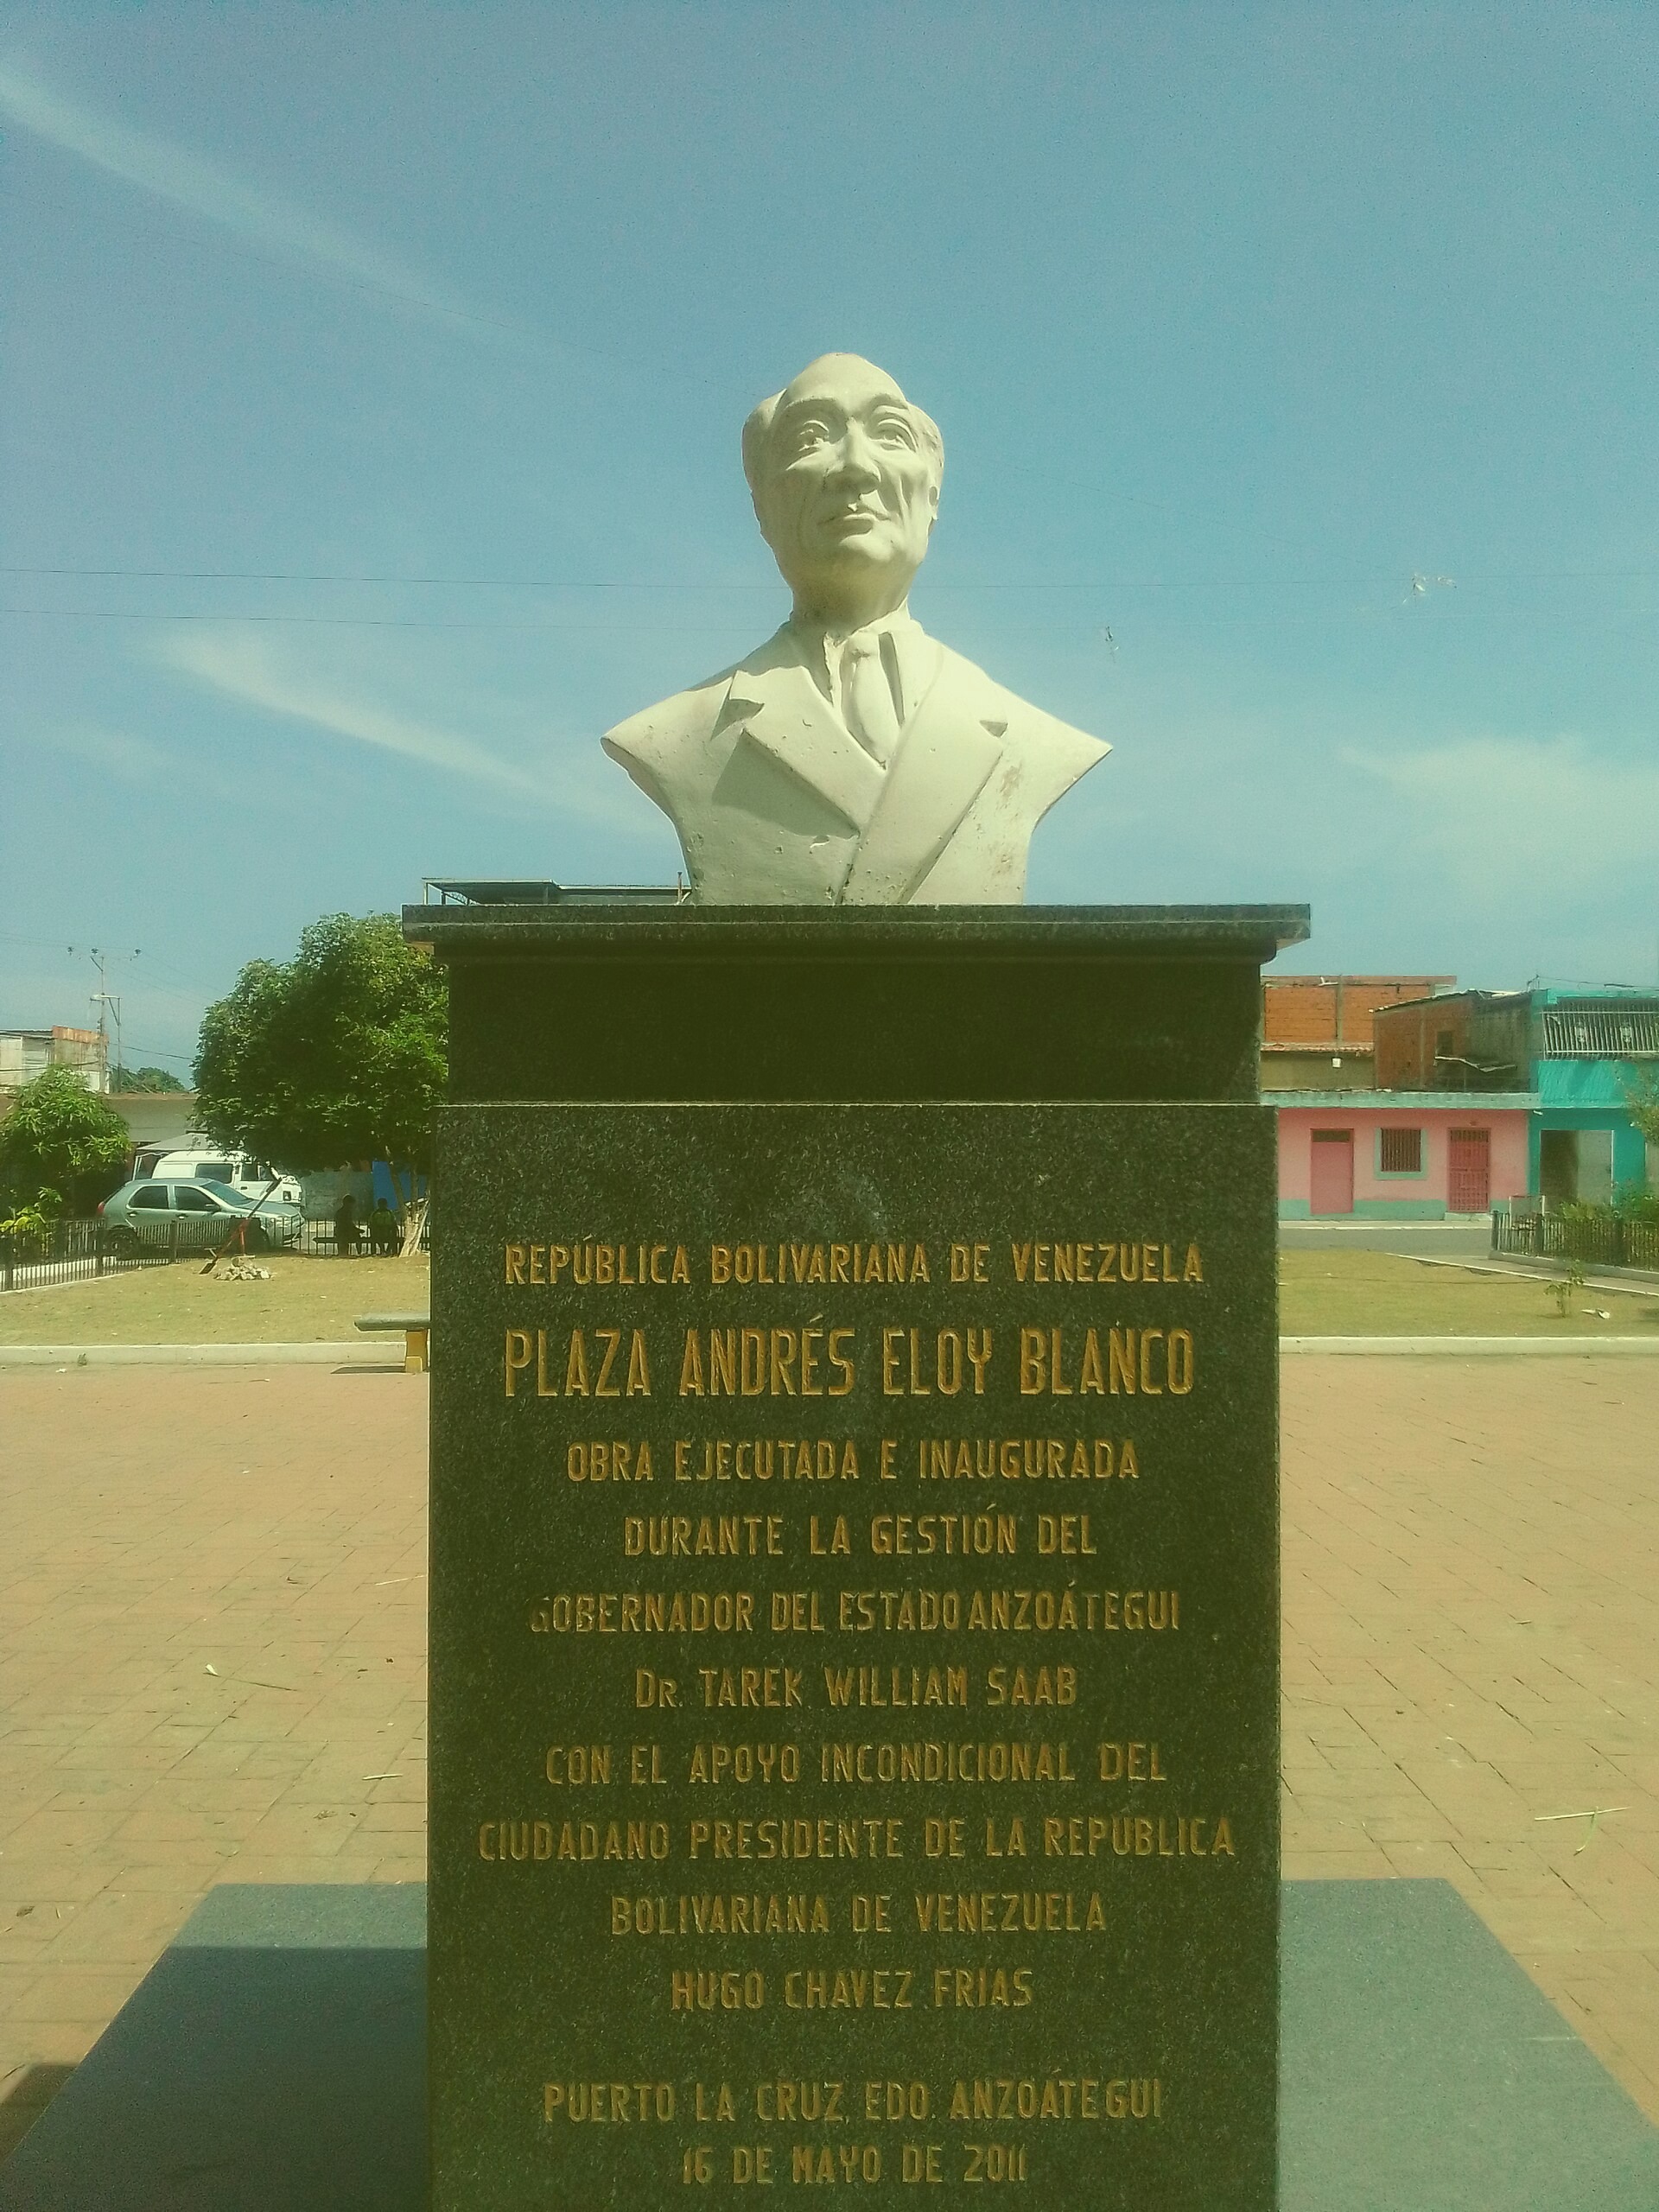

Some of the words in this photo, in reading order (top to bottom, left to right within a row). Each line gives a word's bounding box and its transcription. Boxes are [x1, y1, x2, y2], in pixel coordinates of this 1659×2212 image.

[505, 1233, 690, 1284] REPÚBLICA
[711, 1243, 930, 1284] BOLIVARIANA
[950, 1244, 989, 1283] DE
[1011, 1243, 1203, 1283] VENEZUELA
[505, 1328, 652, 1396] PLAZA
[680, 1313, 855, 1396] ANDRÉS
[883, 1327, 992, 1395] ELOY
[1020, 1327, 1193, 1395] BLANCO
[567, 1442, 653, 1482] OBRA
[675, 1440, 858, 1481] EJECUTADA
[880, 1441, 897, 1480] E
[919, 1440, 1138, 1480] INAUGURADA
[624, 1516, 785, 1555] DURANTE
[810, 1516, 851, 1555] LA
[872, 1504, 1016, 1555] GESTIÓN
[1037, 1515, 1096, 1554] DEL
[772, 1592, 823, 1631] DEL
[839, 1591, 959, 1630] ESTADO
[968, 1580, 1179, 1630] ANZOÁTEGUI
[700, 1669, 804, 1707] TAREK
[826, 1668, 968, 1707] WILLIAM
[988, 1667, 1077, 1706] SAAB
[545, 1745, 610, 1784] CON
[632, 1745, 667, 1783] EL
[690, 1744, 799, 1783] APOYO
[821, 1743, 1075, 1783] INCONDICIONAL
[1101, 1743, 1166, 1782] DEL
[478, 1822, 670, 1862] CIUDADANO
[690, 1820, 904, 1860] PRESIDENTE
[925, 1819, 965, 1858] DE
[986, 1818, 1027, 1857] LA
[612, 1894, 830, 1935] BOLIVARIANA
[853, 1894, 891, 1932] DE
[915, 1893, 1105, 1932] VENEZUELA
[671, 1971, 765, 2010] HUGO
[785, 1971, 912, 2009] CHAVEZ
[544, 2082, 675, 2122] PUERTO
[697, 2082, 735, 2121] LA
[683, 2147, 713, 2183] 16
[734, 2145, 772, 2183] DE
[792, 2145, 880, 2183] MAYO
[903, 2145, 942, 2183] DE
[964, 2144, 1027, 2182] 2011
